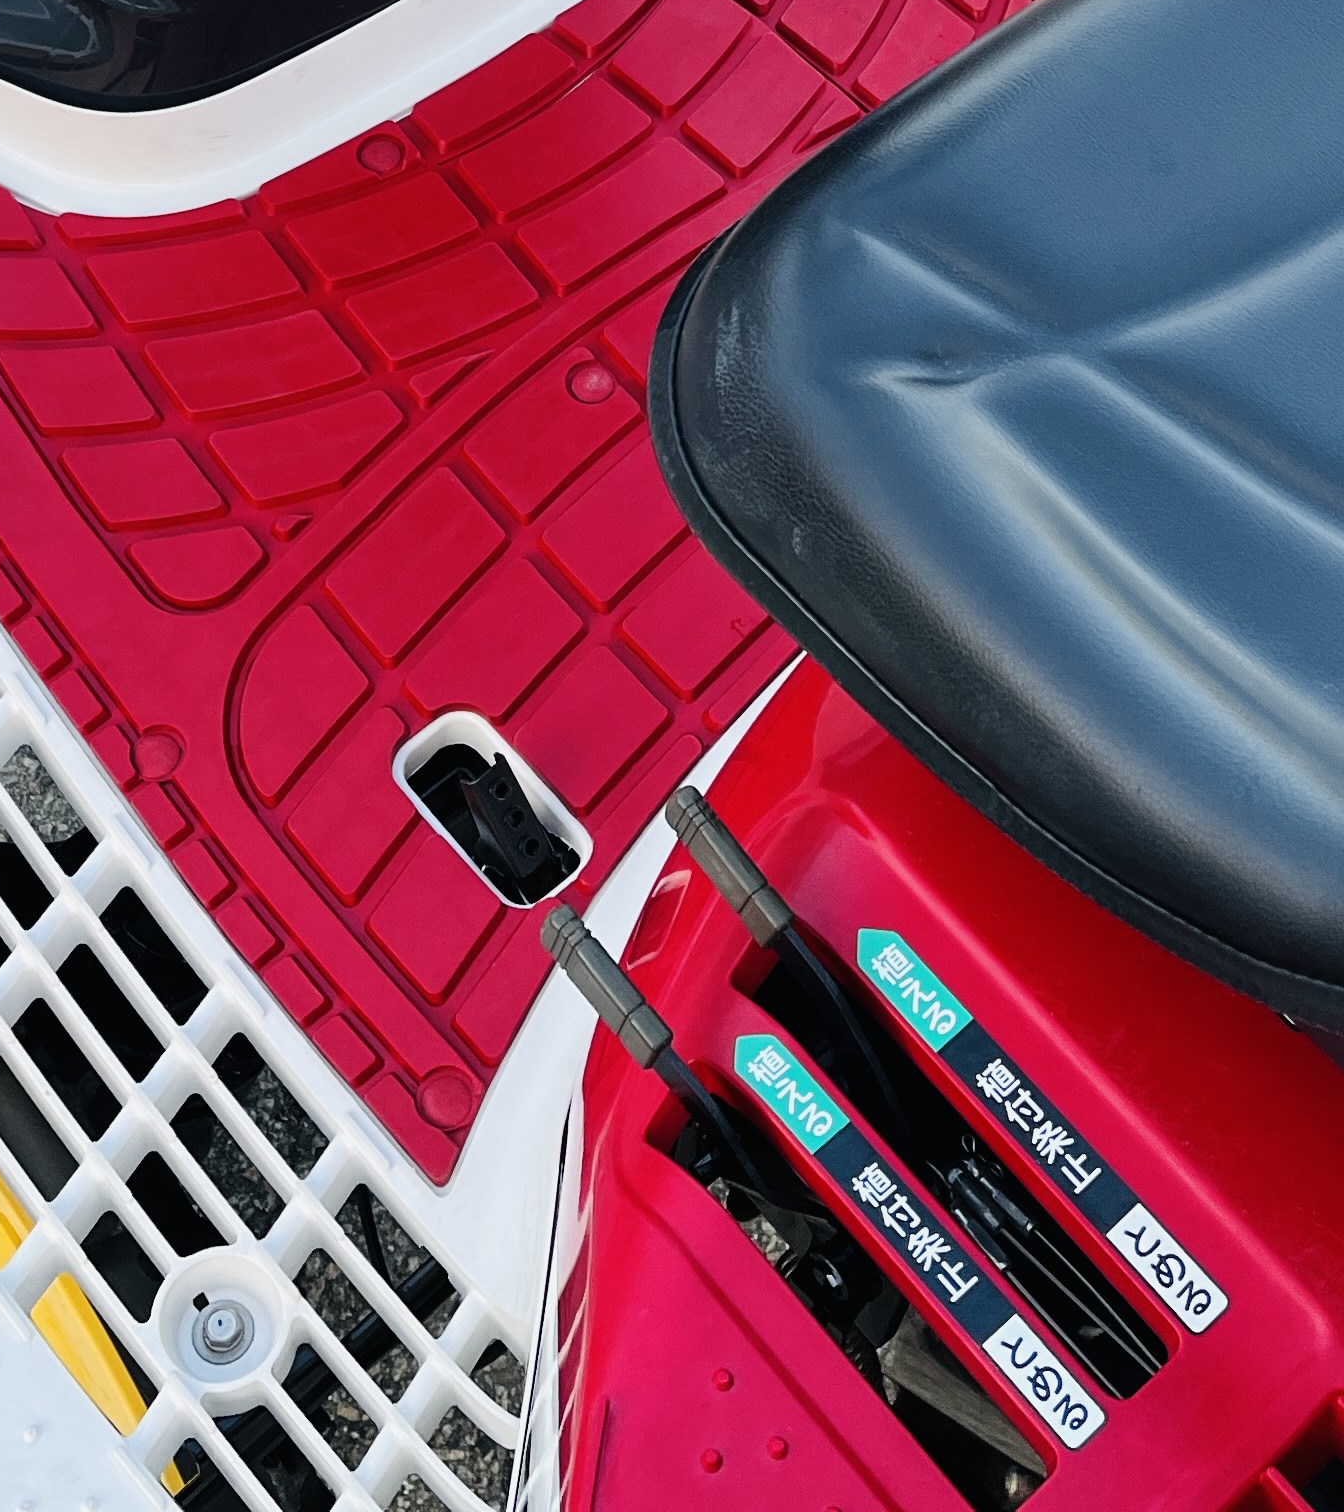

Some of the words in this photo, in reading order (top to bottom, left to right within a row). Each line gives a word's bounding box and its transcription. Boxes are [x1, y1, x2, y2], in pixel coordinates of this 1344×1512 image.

[871, 942, 957, 1035] 植える
[747, 1045, 834, 1137] 植える
[975, 1058, 1102, 1194] 植付条止
[852, 1162, 979, 1303] 植付条止
[1123, 1225, 1212, 1316] とめる
[1001, 1336, 1089, 1431] とめる
